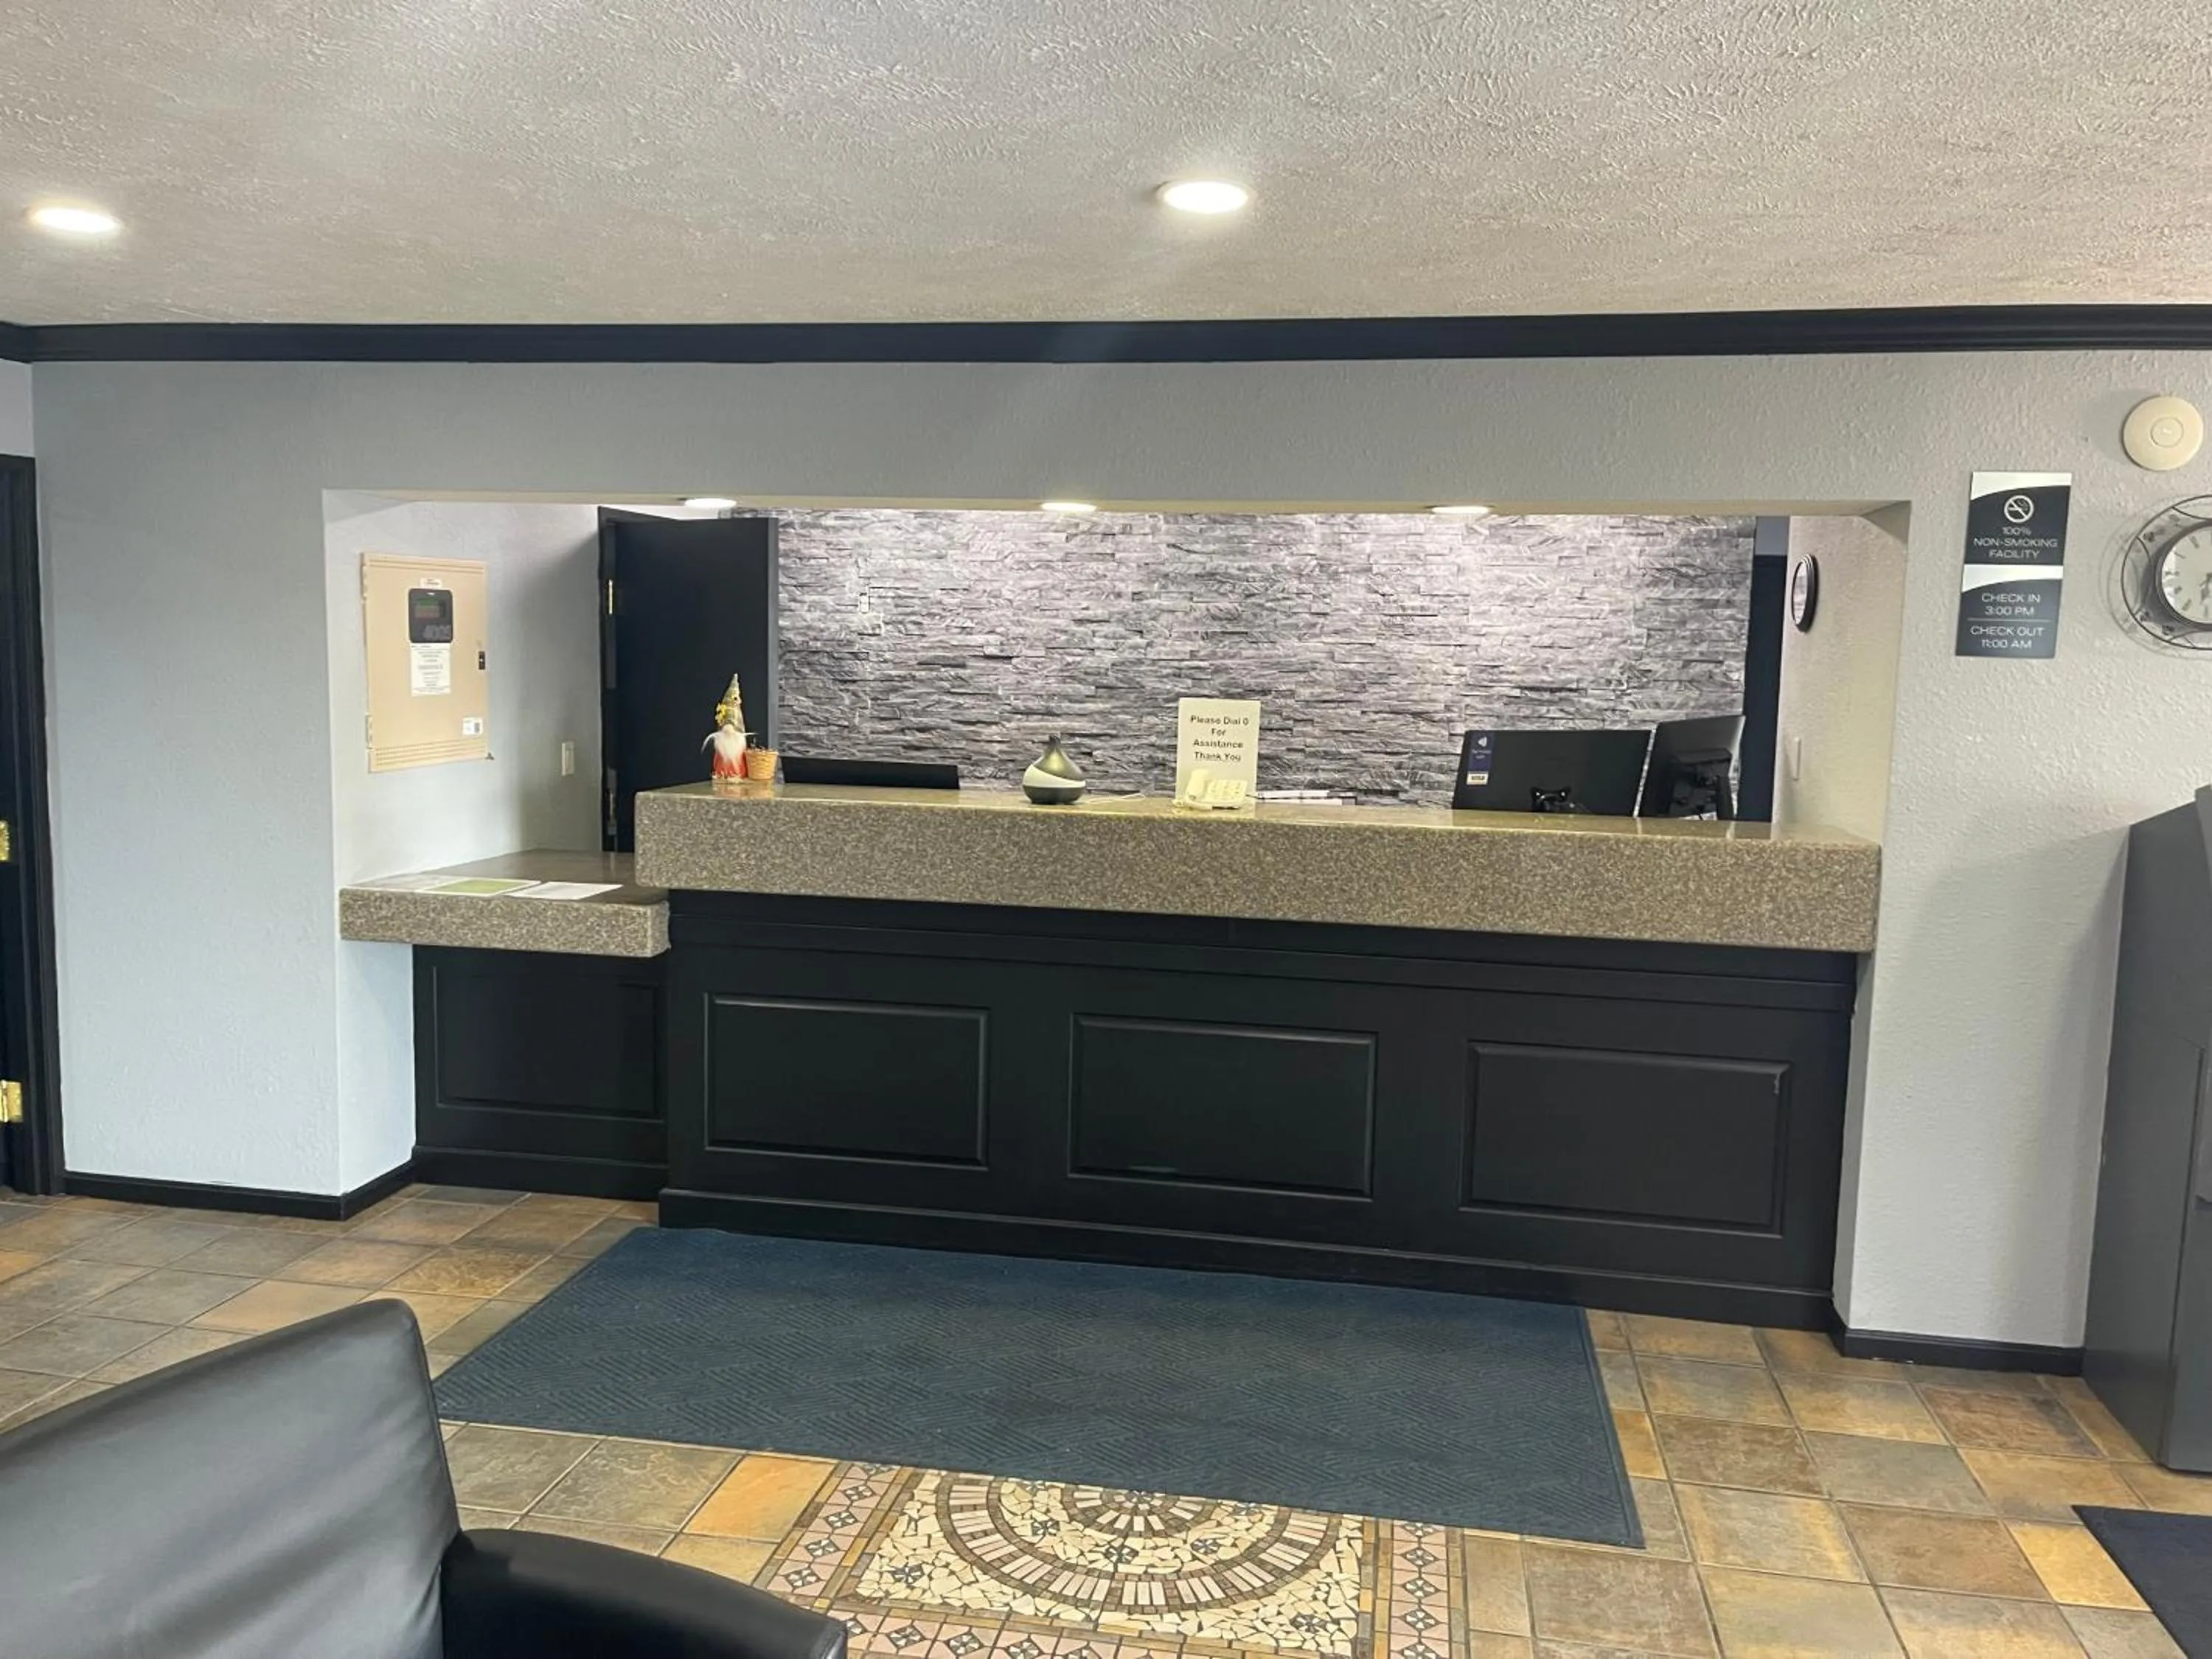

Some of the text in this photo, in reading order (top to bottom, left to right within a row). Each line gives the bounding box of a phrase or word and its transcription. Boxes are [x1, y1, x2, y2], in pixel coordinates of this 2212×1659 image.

[1973, 538, 2059, 548] NON-SMOKING
[1989, 549, 2041, 559] FACILITY
[1981, 593, 2041, 603] CHECK IN
[1984, 605, 2035, 616] 3:00 PM
[1970, 625, 2045, 636] CHECK OUT
[2011, 639, 2033, 649] AM
[1190, 714, 1221, 724] Please
[1223, 716, 1241, 725] Dial
[1211, 728, 1226, 736] For
[1192, 739, 1244, 748] Assistance
[1194, 751, 1242, 762] Thank You
